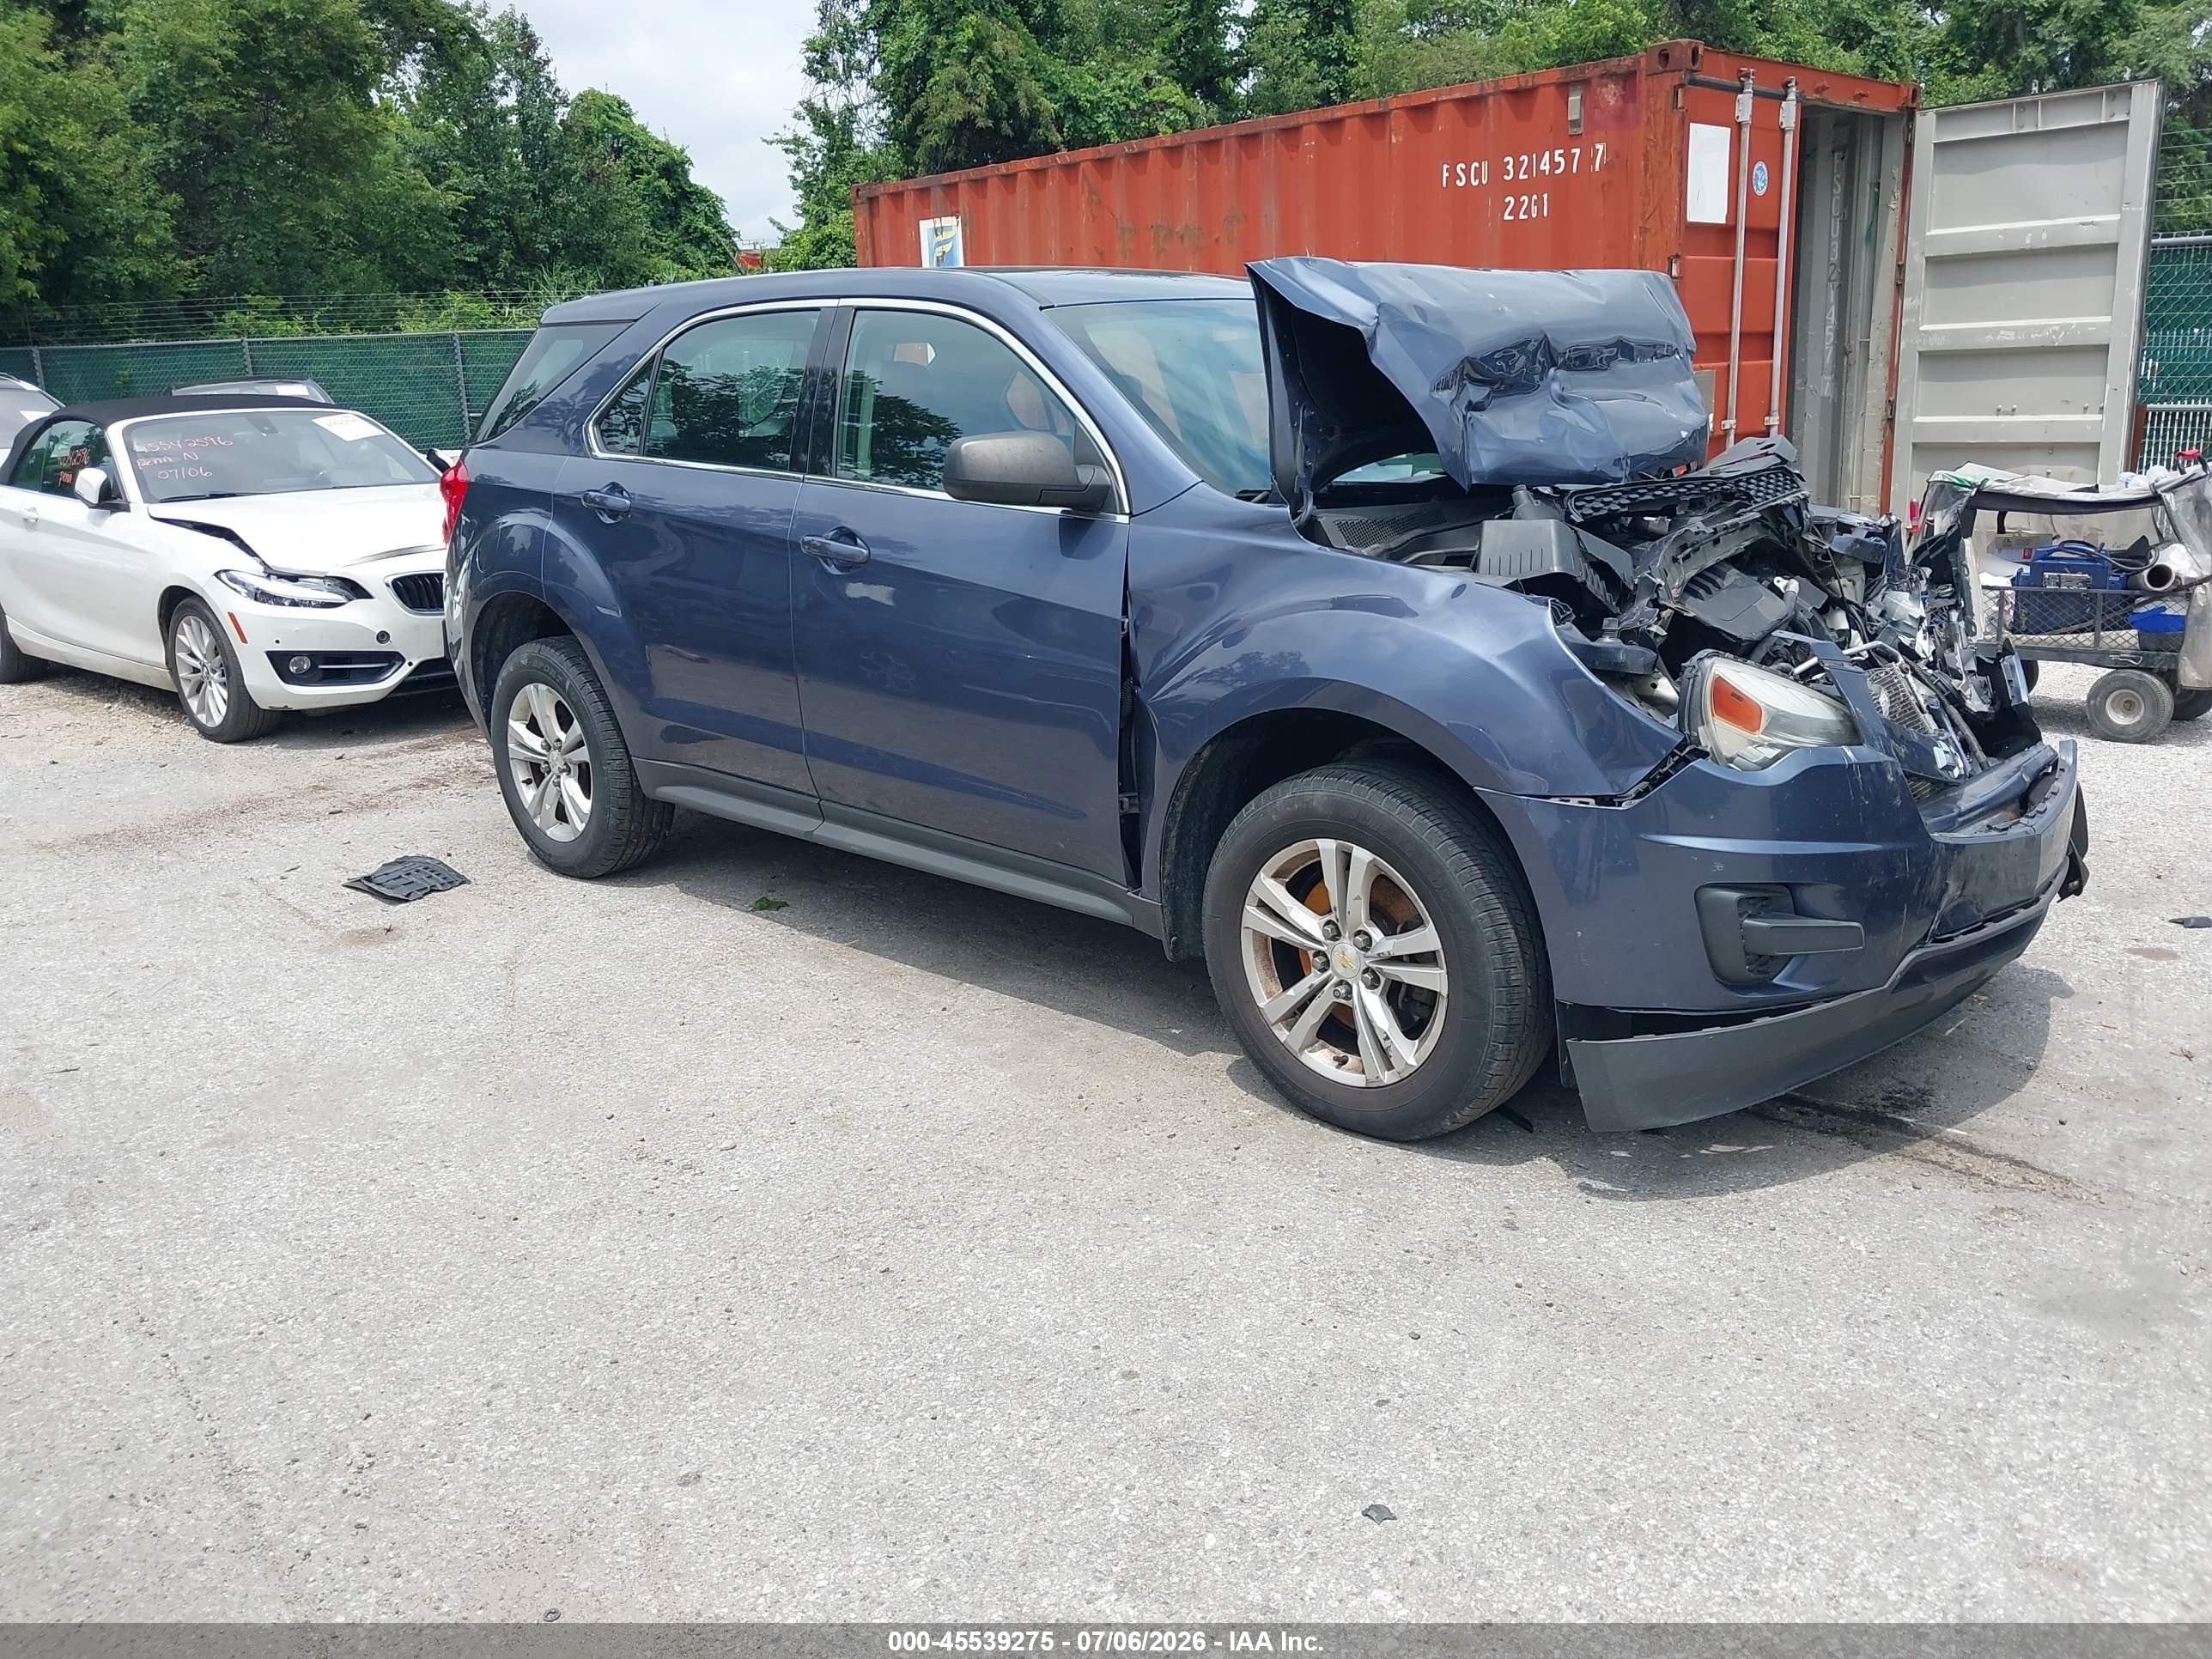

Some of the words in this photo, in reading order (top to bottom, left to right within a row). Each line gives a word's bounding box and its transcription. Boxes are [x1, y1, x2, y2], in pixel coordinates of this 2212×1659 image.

[1442, 160, 1488, 188] FSCU
[1503, 148, 1581, 181] 321457
[1592, 143, 1607, 173] 7
[1503, 192, 1548, 221] 22G1
